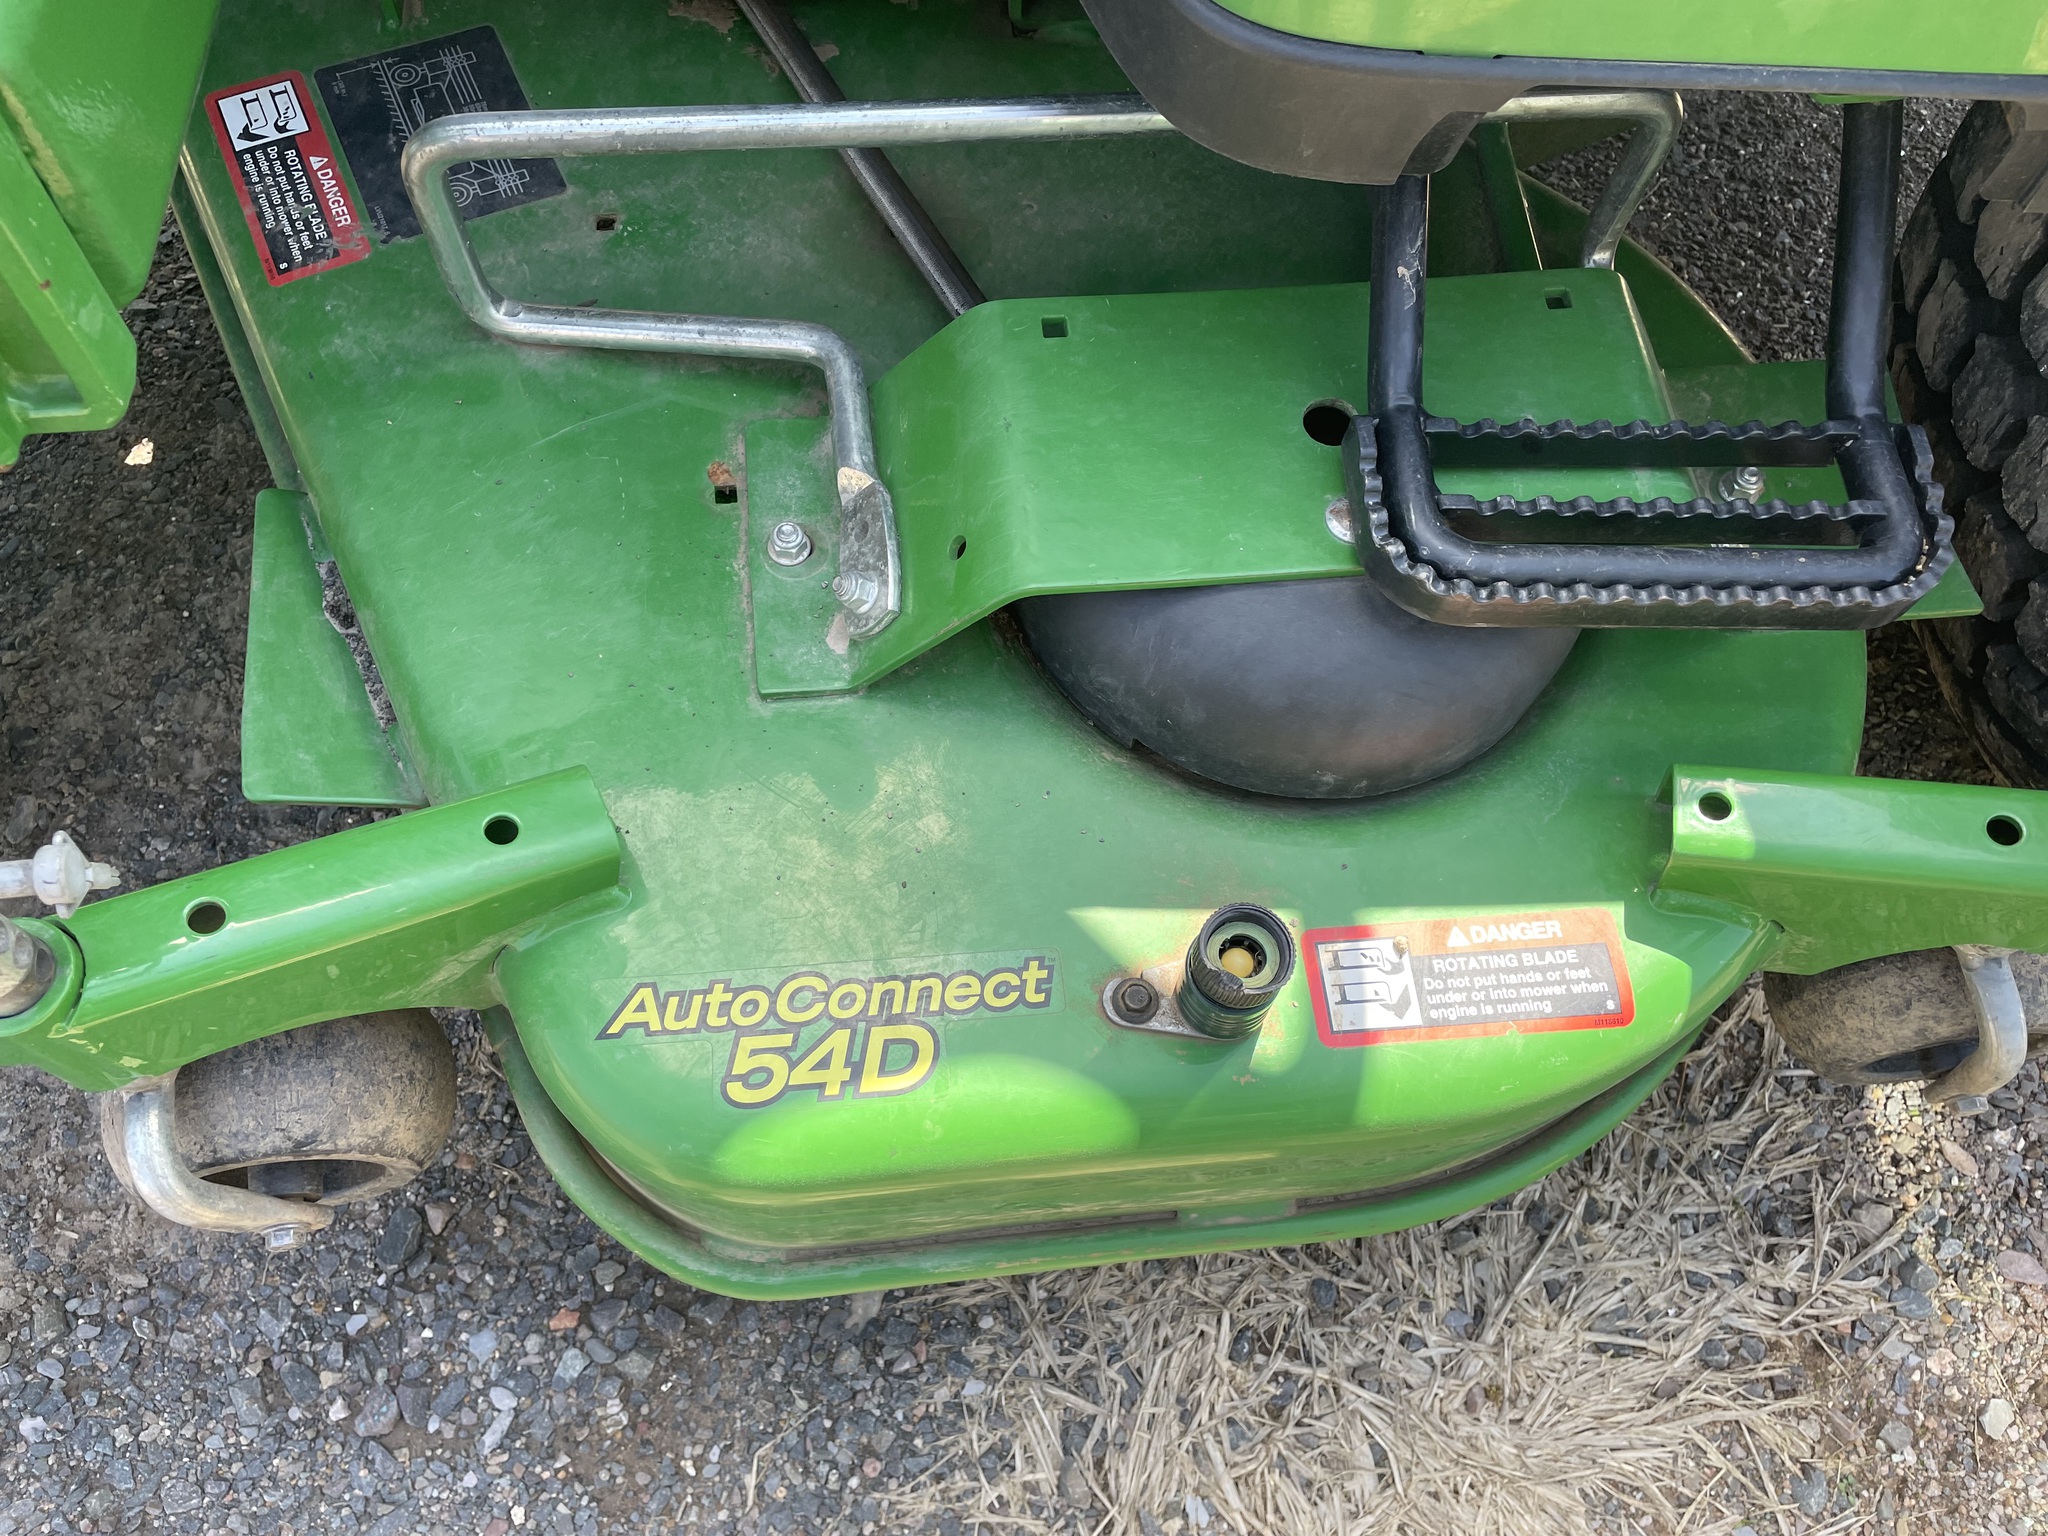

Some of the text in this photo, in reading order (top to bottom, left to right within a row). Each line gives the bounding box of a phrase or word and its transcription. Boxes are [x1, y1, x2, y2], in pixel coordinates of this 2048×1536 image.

[267, 146, 278, 161] Do
[272, 160, 285, 176] not
[285, 149, 313, 202] ROTATING
[243, 154, 275, 229] engine is running
[278, 175, 291, 190] put
[255, 150, 303, 262] under or into mower when
[317, 169, 351, 227] DANGER
[295, 221, 305, 231] or
[300, 231, 313, 250] feet
[1470, 920, 1562, 943] DANGER
[1433, 950, 1579, 973] ROTATING BLADE
[1423, 967, 1591, 990] Do not put hands or feet
[594, 955, 1055, 1041] AutoConnect
[1427, 981, 1608, 1004] under or into mower when
[1430, 1000, 1552, 1020] engine is running
[721, 1021, 940, 1109] 54D
